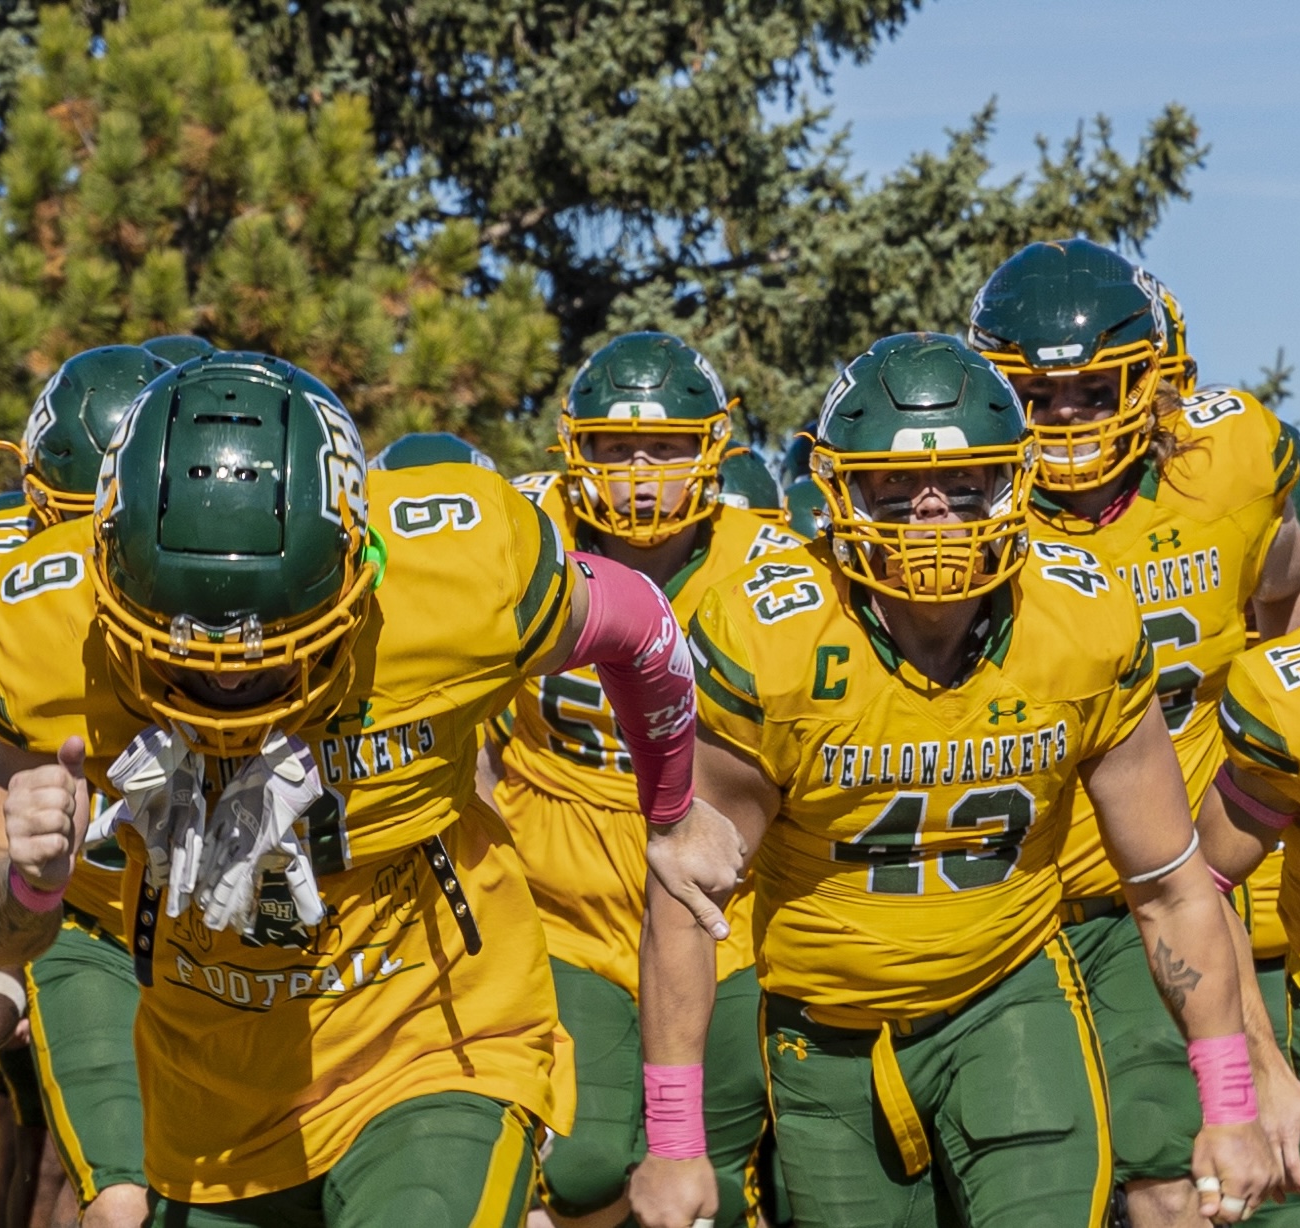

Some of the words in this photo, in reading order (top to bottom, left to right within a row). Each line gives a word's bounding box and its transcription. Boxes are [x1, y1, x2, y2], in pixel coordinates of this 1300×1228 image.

[743, 562, 825, 625] 43
[1032, 541, 1109, 599] 43
[1117, 546, 1221, 607] ACKETS
[812, 646, 850, 700] C
[821, 720, 1068, 789] YELLOWJACKETS
[830, 784, 1036, 896] 43
[259, 900, 295, 922] BH
